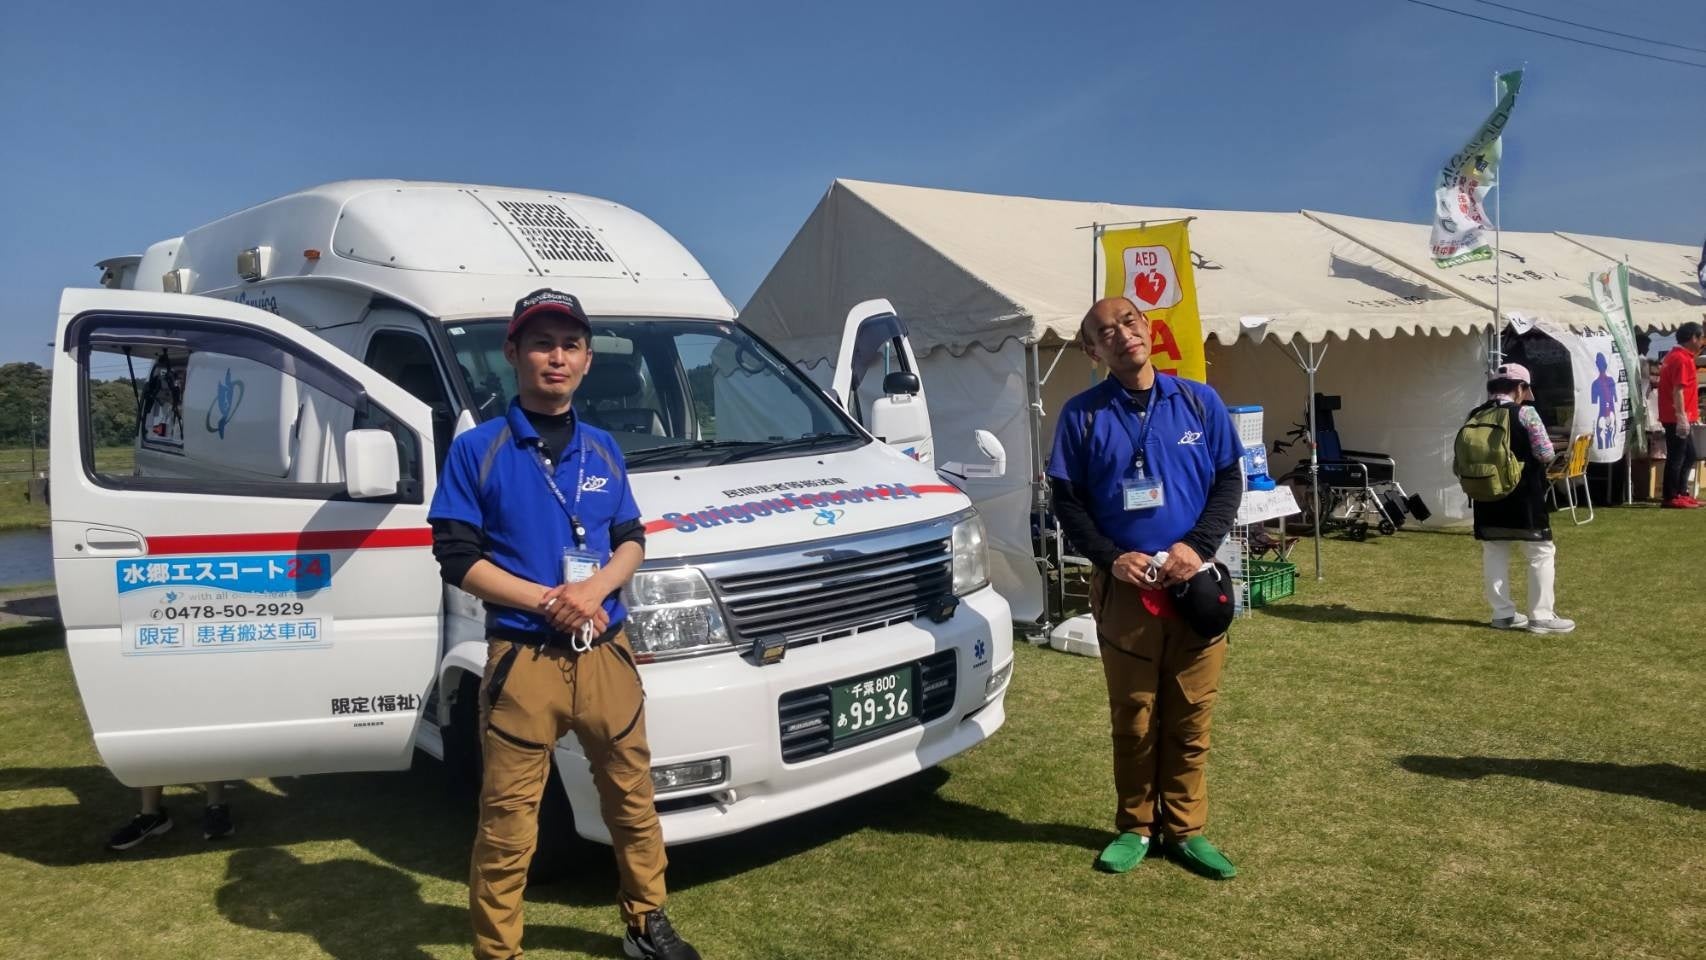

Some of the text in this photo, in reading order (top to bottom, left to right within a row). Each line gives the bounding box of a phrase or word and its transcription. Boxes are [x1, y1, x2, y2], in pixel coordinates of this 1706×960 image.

[1135, 251, 1158, 266] AED
[165, 602, 304, 620] 0478-50-2929
[139, 621, 316, 646] 限定 患者搬送車両
[851, 674, 896, 698] 千葉 800
[331, 693, 422, 715] 限定(福祉)
[837, 688, 908, 730] あ 99-36
